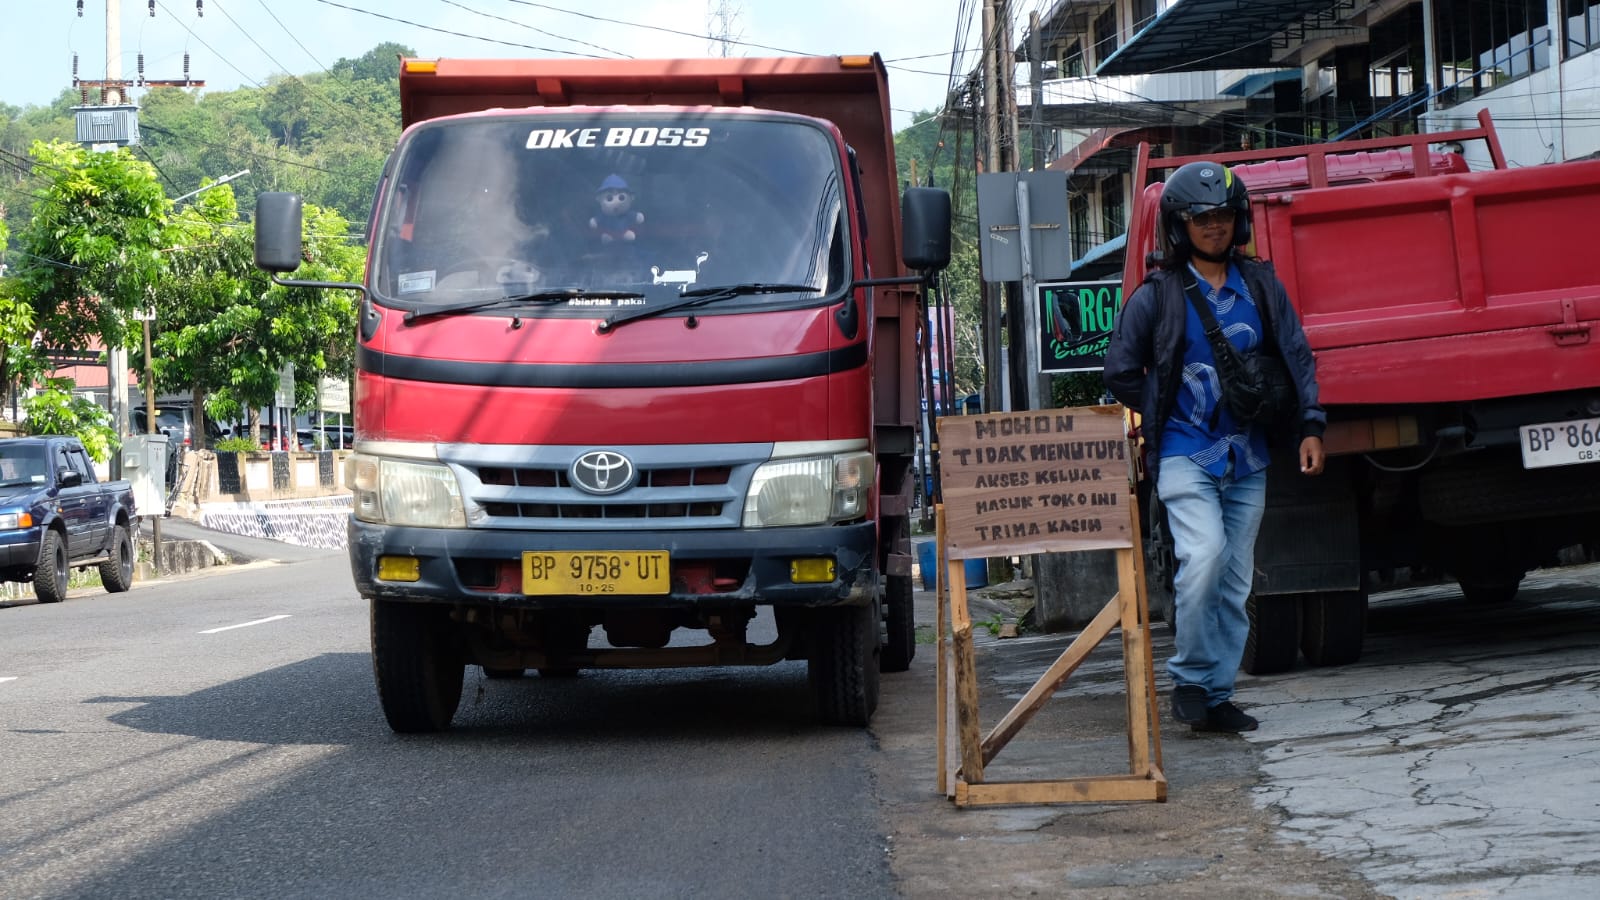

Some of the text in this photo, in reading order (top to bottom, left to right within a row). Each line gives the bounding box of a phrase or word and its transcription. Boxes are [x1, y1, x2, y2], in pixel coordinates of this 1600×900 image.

[525, 127, 710, 149] OKE BOSS
[617, 297, 646, 307] pakai
[975, 415, 1074, 439] MOHON
[1528, 427, 1555, 452] BP
[953, 440, 1124, 465] TIDAK MENUTUPI
[975, 468, 1102, 488] AKSES KELUAR
[976, 492, 1117, 515] MASUK TOKO INI
[975, 518, 1102, 541] TRIMA KASIH
[531, 555, 662, 580] BP 9758 UT
